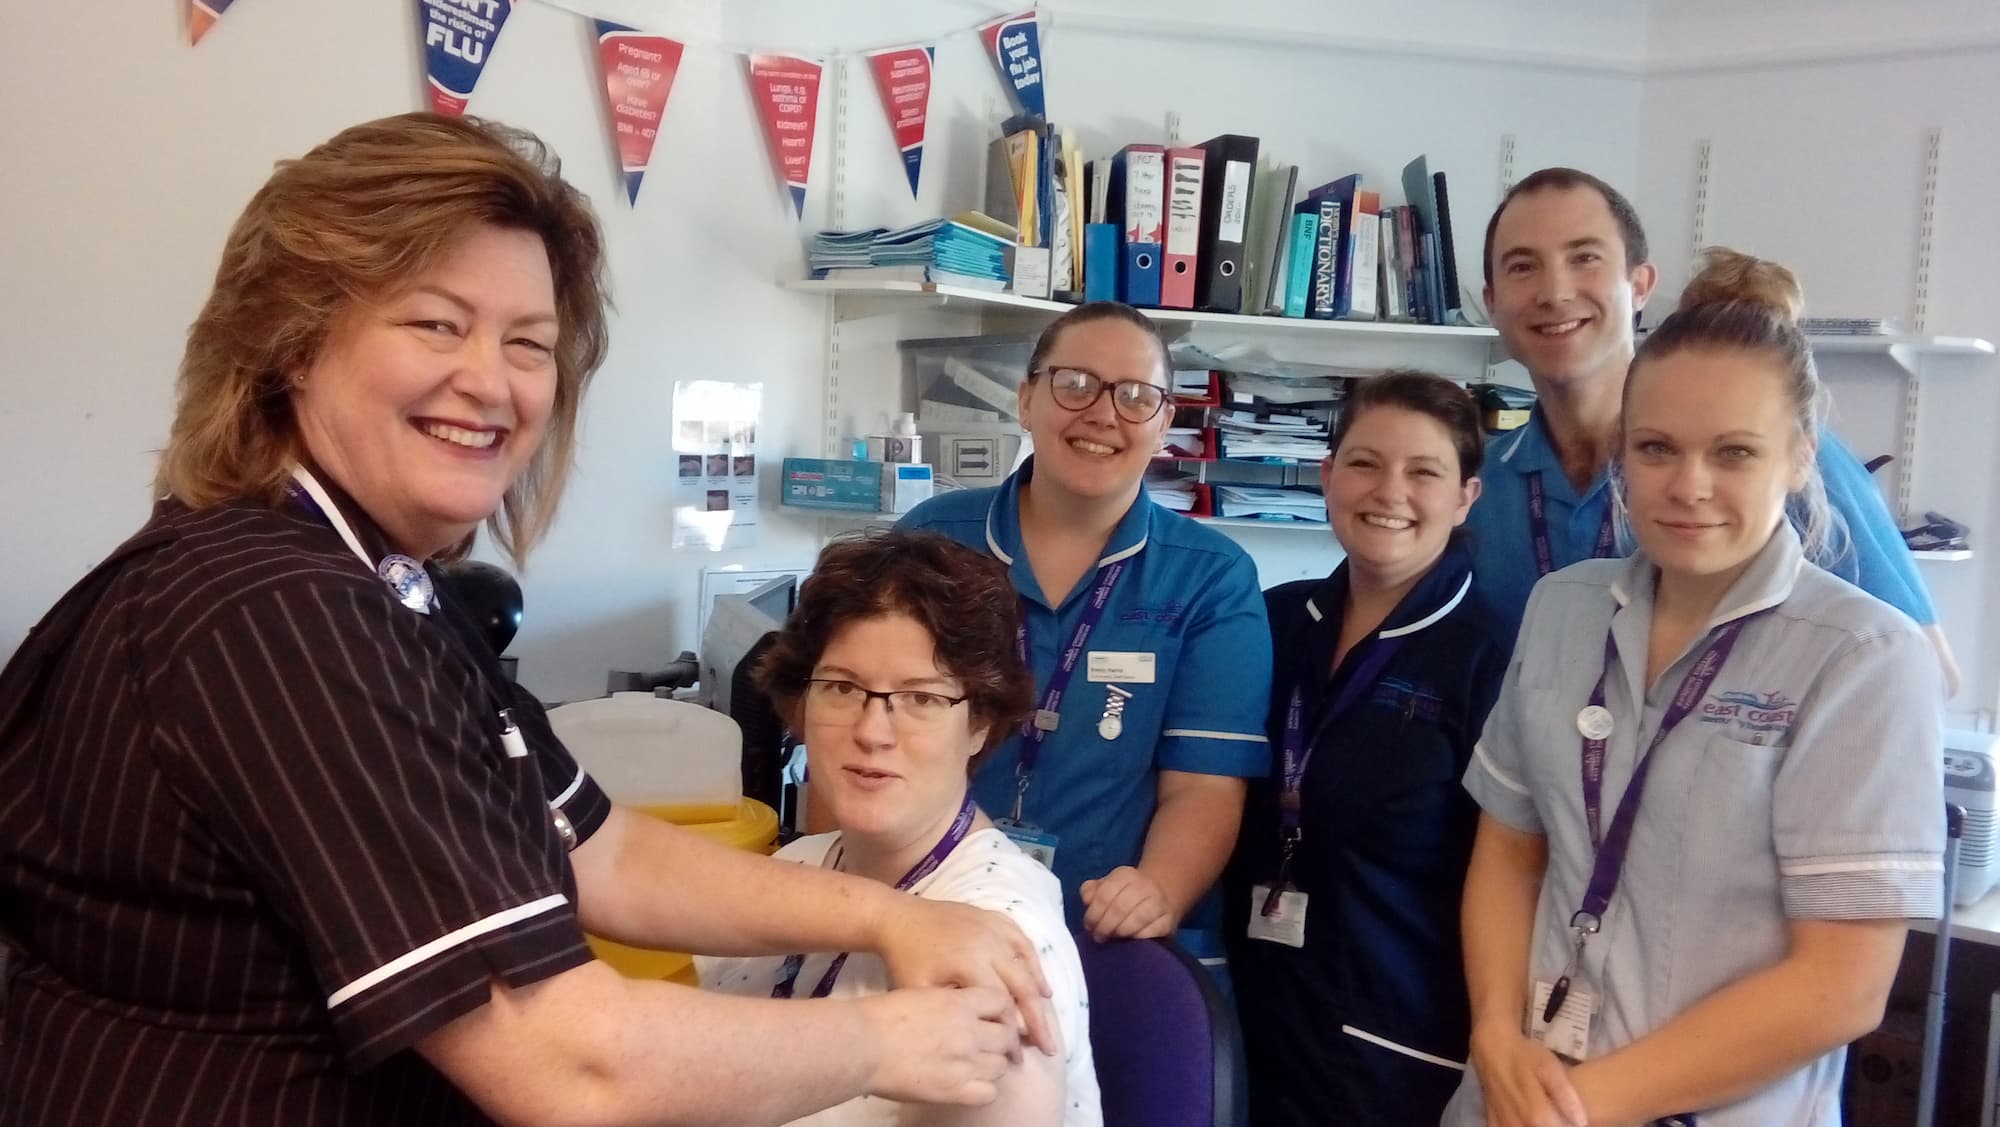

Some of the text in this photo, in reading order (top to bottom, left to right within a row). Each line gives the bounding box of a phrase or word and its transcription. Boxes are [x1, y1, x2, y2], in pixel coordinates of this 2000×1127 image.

[429, 8, 487, 40] the risks of
[426, 22, 483, 64] FLU
[1002, 31, 1027, 49] Book
[618, 43, 662, 63] Pregnant?
[1008, 45, 1028, 61] your
[1009, 56, 1037, 76] flu jab
[1014, 72, 1040, 90] today
[616, 104, 657, 120] diabetes?
[778, 103, 802, 114] COPD?
[1304, 219, 1313, 240] BNF
[1315, 207, 1334, 305] DICTIONARY
[1703, 703, 1741, 717] east
[1748, 709, 1794, 725] coast
